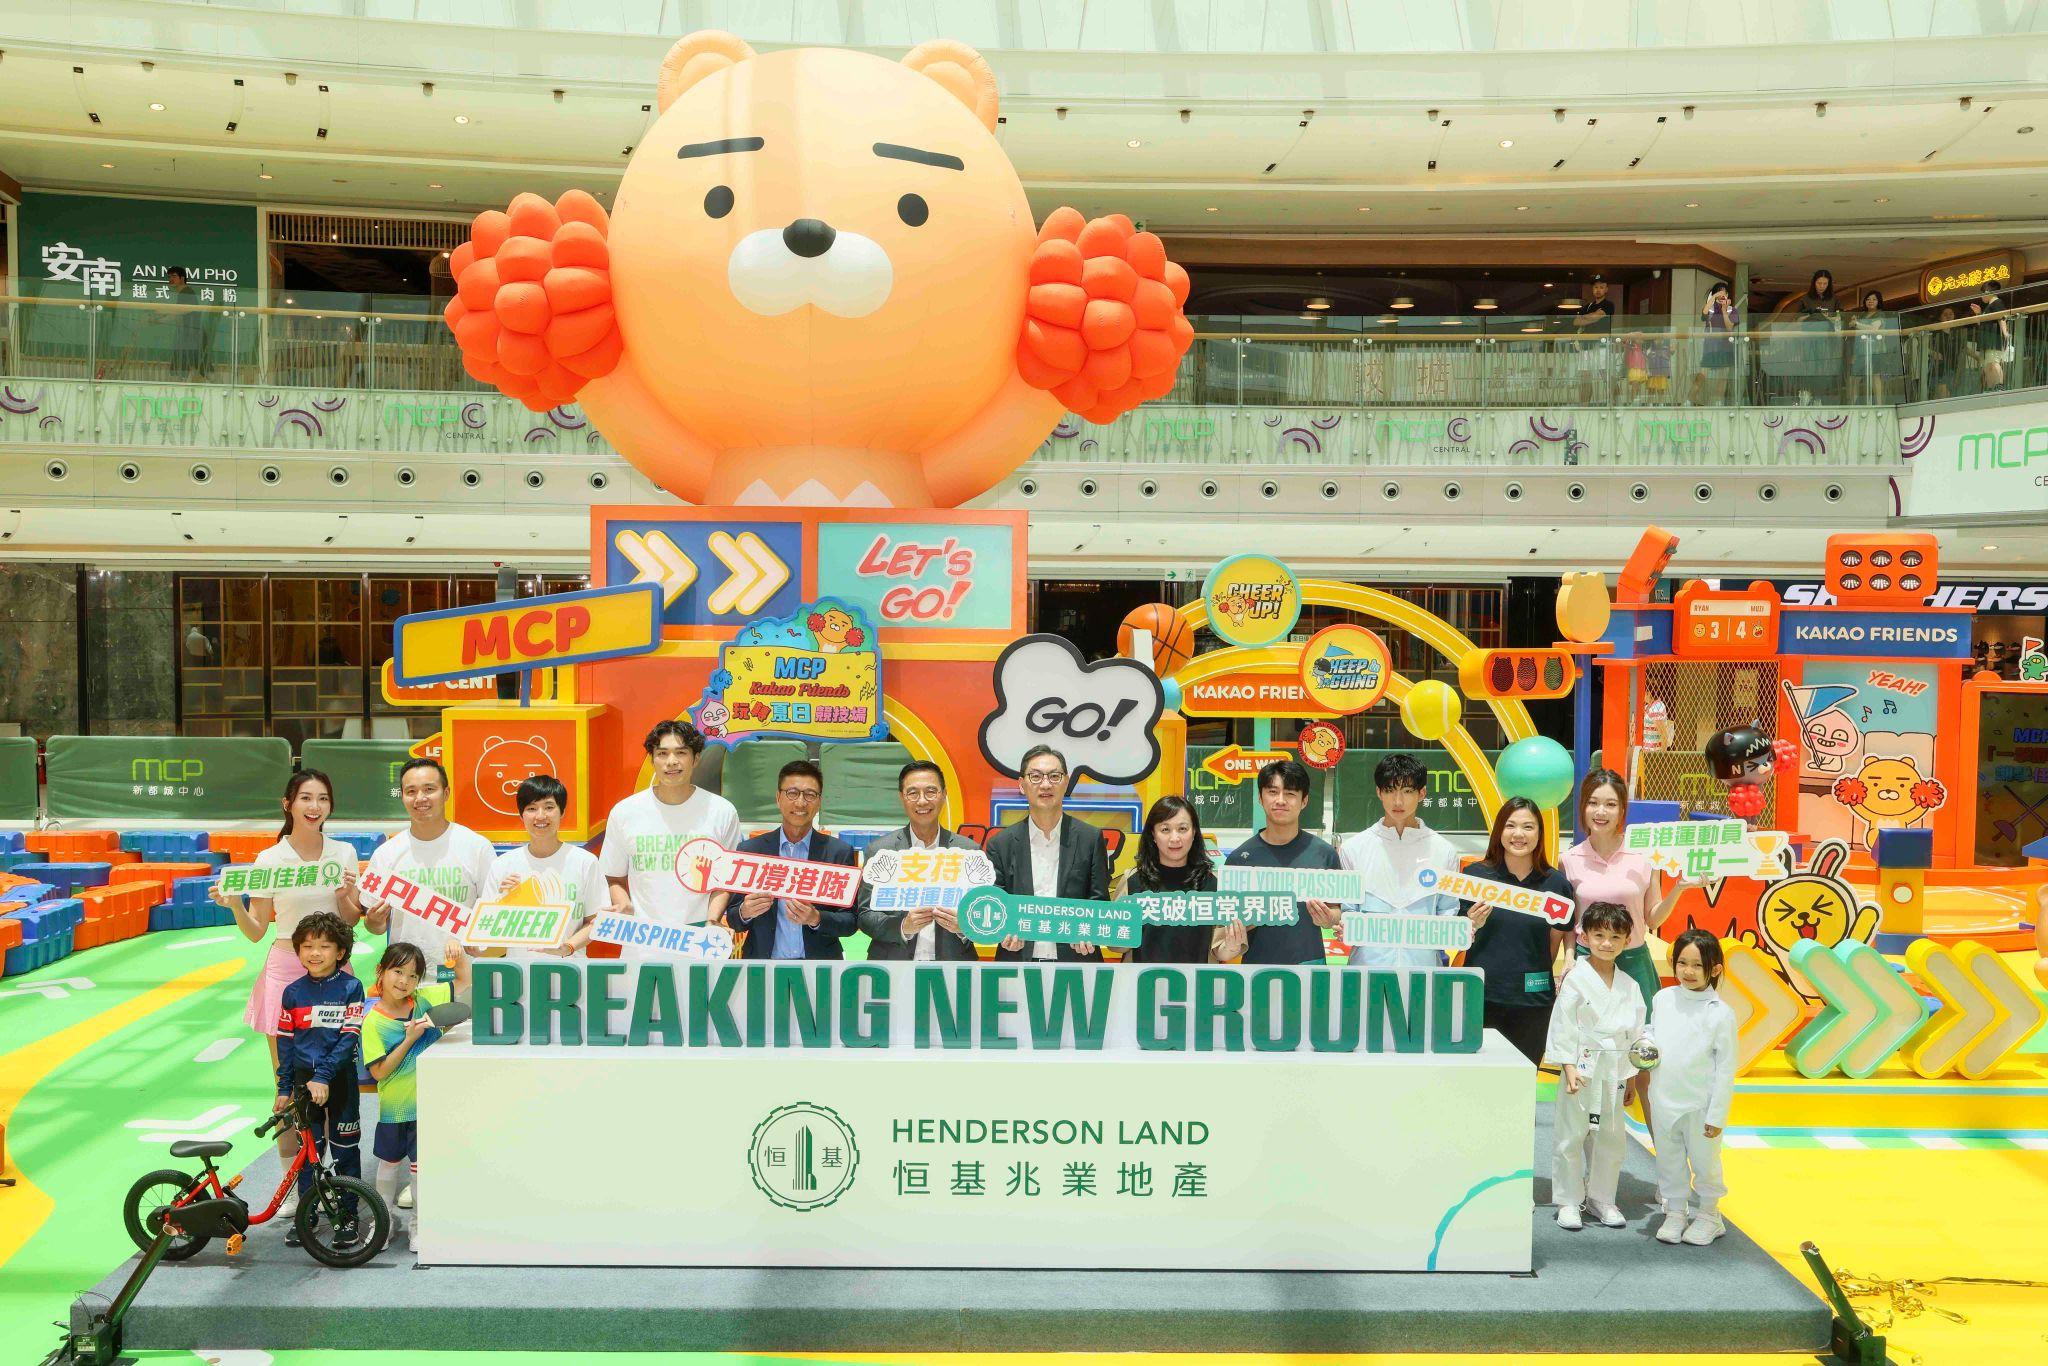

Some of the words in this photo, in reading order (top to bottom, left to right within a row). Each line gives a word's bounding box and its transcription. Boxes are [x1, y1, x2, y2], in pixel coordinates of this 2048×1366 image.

[42, 241, 122, 297] 安南
[132, 264, 157, 278] AN
[161, 265, 200, 280] NM
[204, 268, 238, 282] PHO
[132, 284, 237, 303] 越式肉粉
[445, 432, 486, 440] CENTRAL
[857, 535, 972, 577] LET'S
[879, 580, 972, 620] GO!
[1227, 583, 1285, 602] CHEER
[1249, 601, 1281, 620] UP!
[1693, 604, 1710, 612] RYAN
[462, 606, 591, 665] MCP
[1710, 621, 1720, 639] 3
[1735, 621, 1747, 640] 4
[1796, 625, 1864, 640] KAKAO
[1870, 627, 1958, 643] FRIENDS
[774, 656, 826, 680] MCP
[1330, 658, 1369, 674] KEEP
[749, 681, 796, 697] Kakao
[798, 683, 851, 698] Friends
[1193, 685, 1256, 700] KAKAO
[1329, 674, 1378, 690] GOING
[1868, 670, 1929, 696] YEAH!
[1024, 695, 1139, 742] GO!
[1224, 759, 1253, 771] ONE
[1731, 764, 1742, 776] N
[132, 785, 205, 797] 新都城中心
[1188, 795, 1235, 805] 城中心
[1422, 797, 1478, 808] 新都城中
[1629, 824, 1742, 848] 香港運動員
[897, 853, 966, 885] 支持
[1687, 848, 1749, 877] 世一
[223, 864, 319, 892] 再創佳績
[1297, 872, 1361, 899] PASSION
[361, 872, 472, 935] #PLAY
[876, 887, 970, 907] 香港運動
[1437, 874, 1543, 914] #ENGAGE
[1018, 903, 1094, 918] HENDERSON
[1098, 909, 1132, 921] LAND
[477, 909, 559, 939] #CHEER
[597, 917, 695, 952] #INSPIRE
[1018, 918, 1132, 940] 恒基兆業地產
[1345, 915, 1364, 943] TO
[1367, 917, 1401, 944] NEW
[1406, 918, 1468, 946] HEIGHTS
[471, 962, 891, 1049] BREAKING
[914, 964, 1115, 1051] NEW
[1135, 967, 1485, 1055] GROUND
[892, 1118, 1104, 1145] HENDERSON
[1118, 1120, 1209, 1145] LAND
[764, 1146, 787, 1168] 恒
[821, 1146, 843, 1168] 基
[892, 1159, 1208, 1198] 恒基兆業地產
